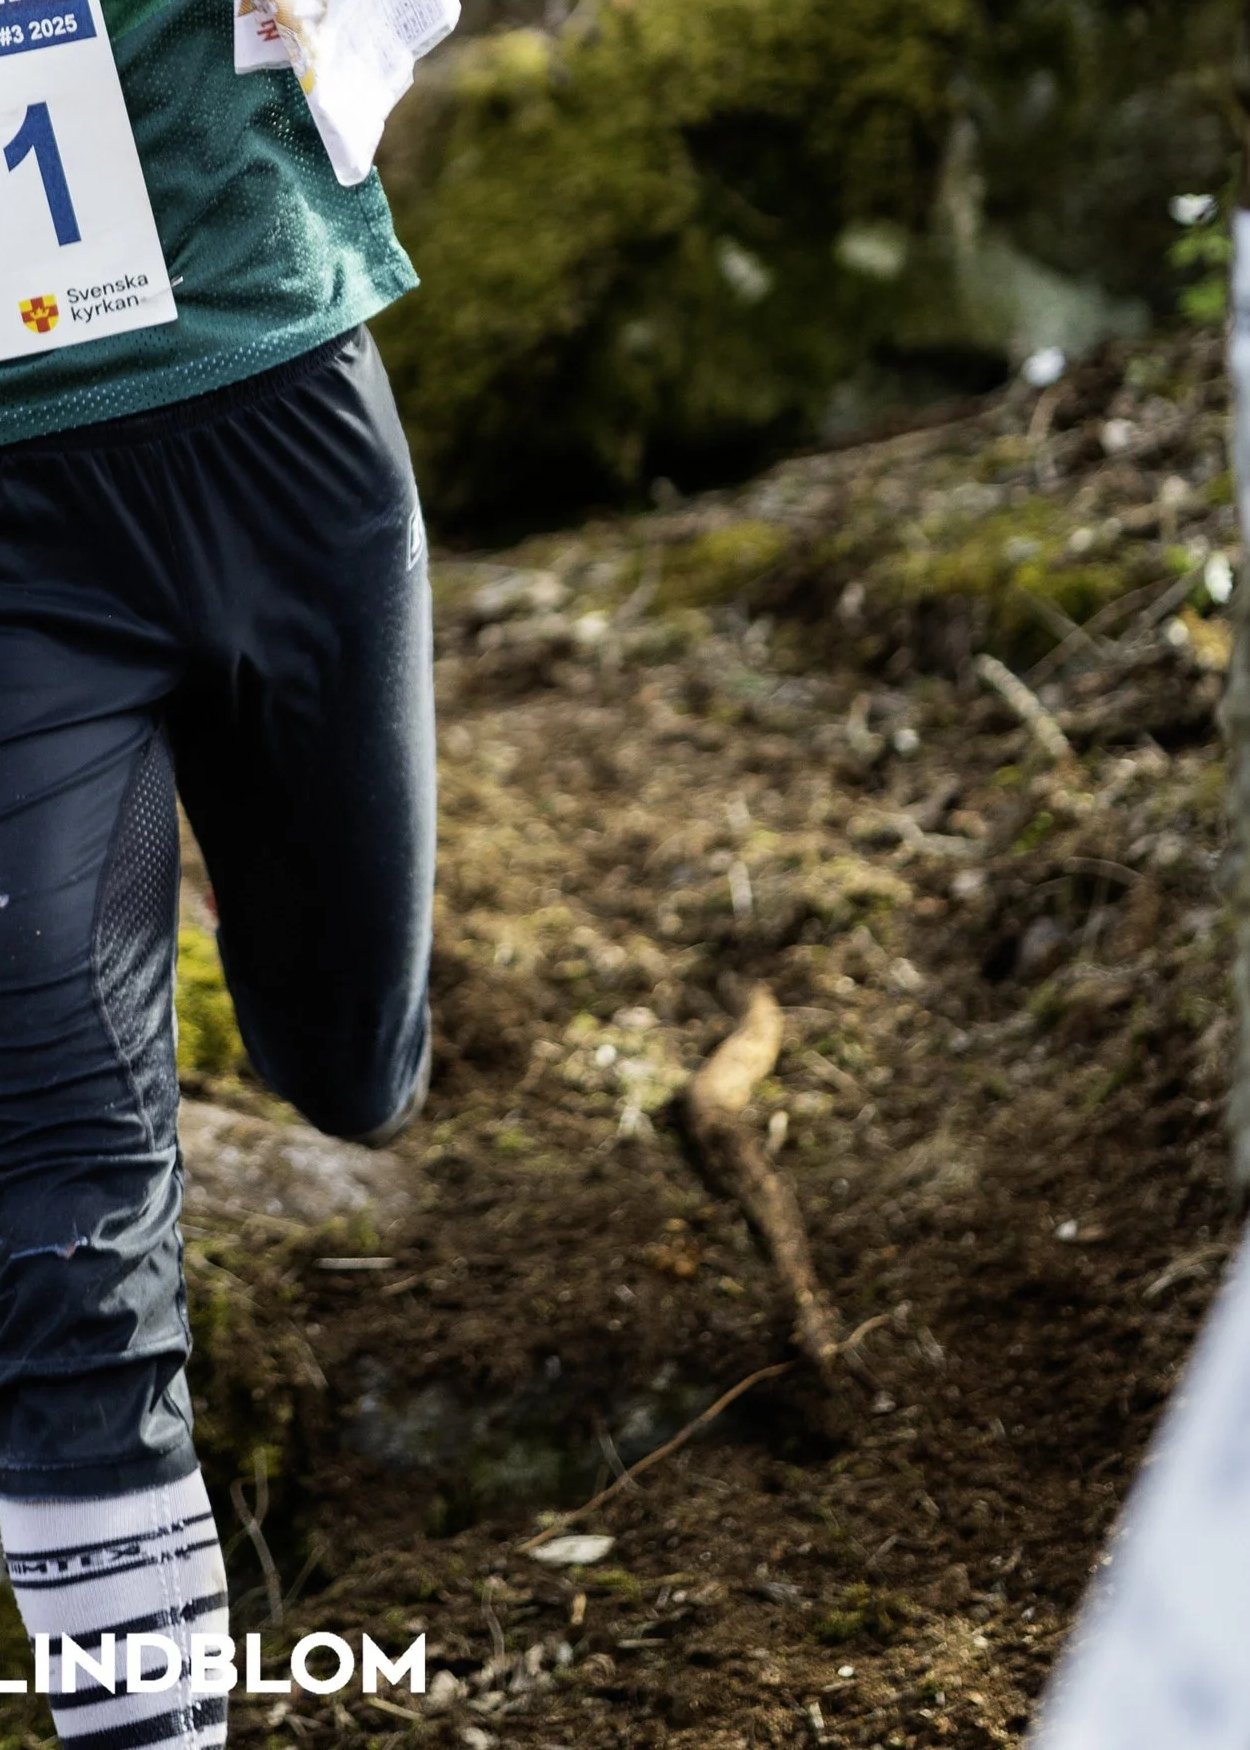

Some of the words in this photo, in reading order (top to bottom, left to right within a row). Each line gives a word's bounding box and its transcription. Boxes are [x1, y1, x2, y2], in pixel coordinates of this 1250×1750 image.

[28, 13, 79, 42] 2025
[66, 273, 149, 304] Svenska
[70, 294, 140, 324] kyrkan
